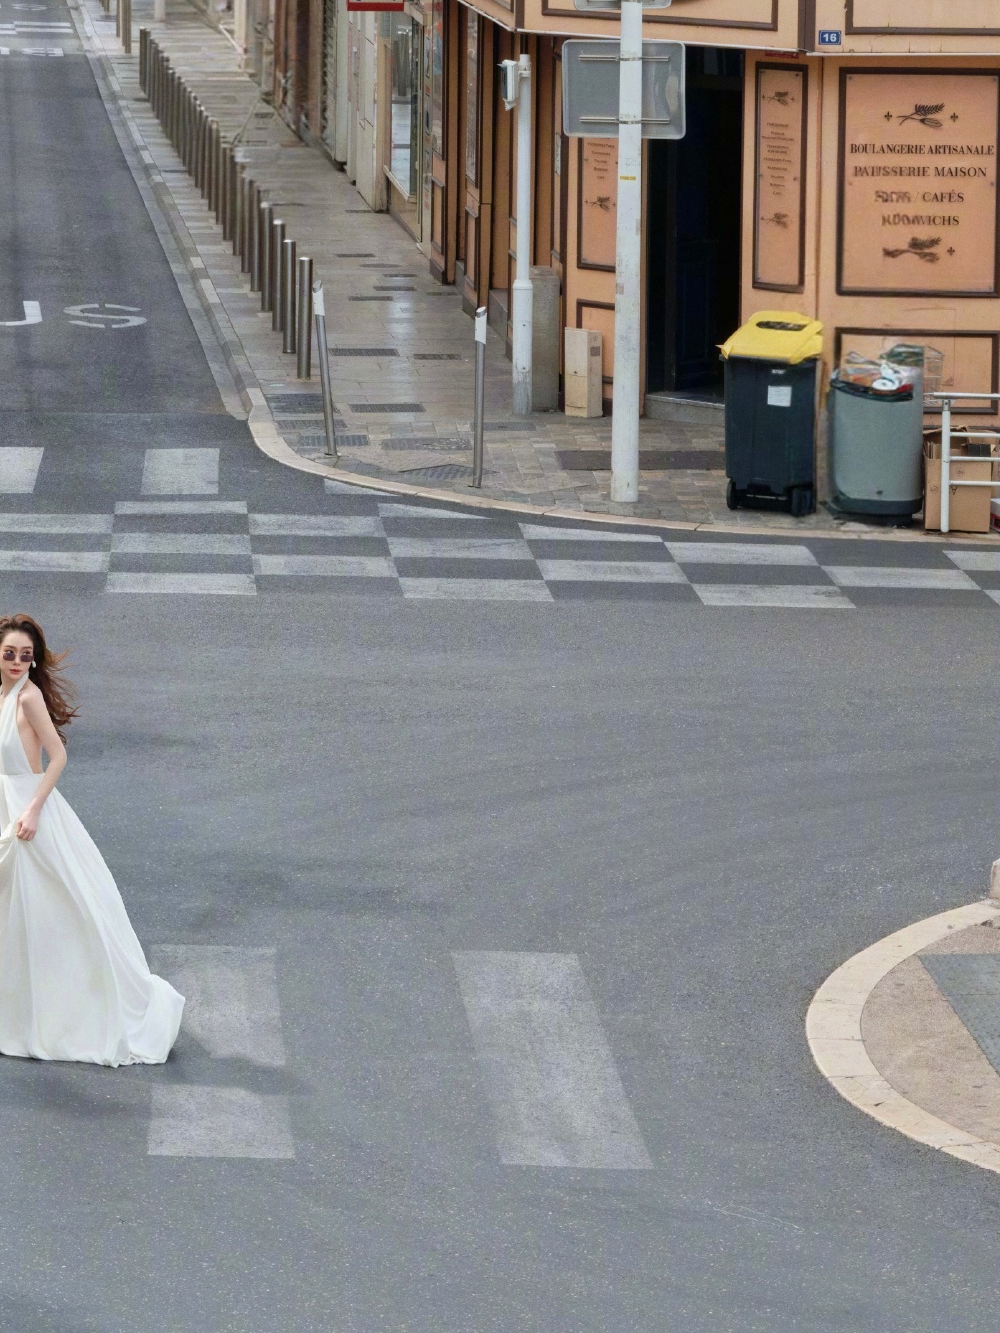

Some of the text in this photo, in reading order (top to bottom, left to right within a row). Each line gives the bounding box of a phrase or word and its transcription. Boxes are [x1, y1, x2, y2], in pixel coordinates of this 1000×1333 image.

[823, 33, 837, 42] 16
[850, 143, 995, 156] BOULANGERIE ARTISANALE
[934, 166, 987, 178] MAISON
[922, 189, 965, 203] CAFÉS
